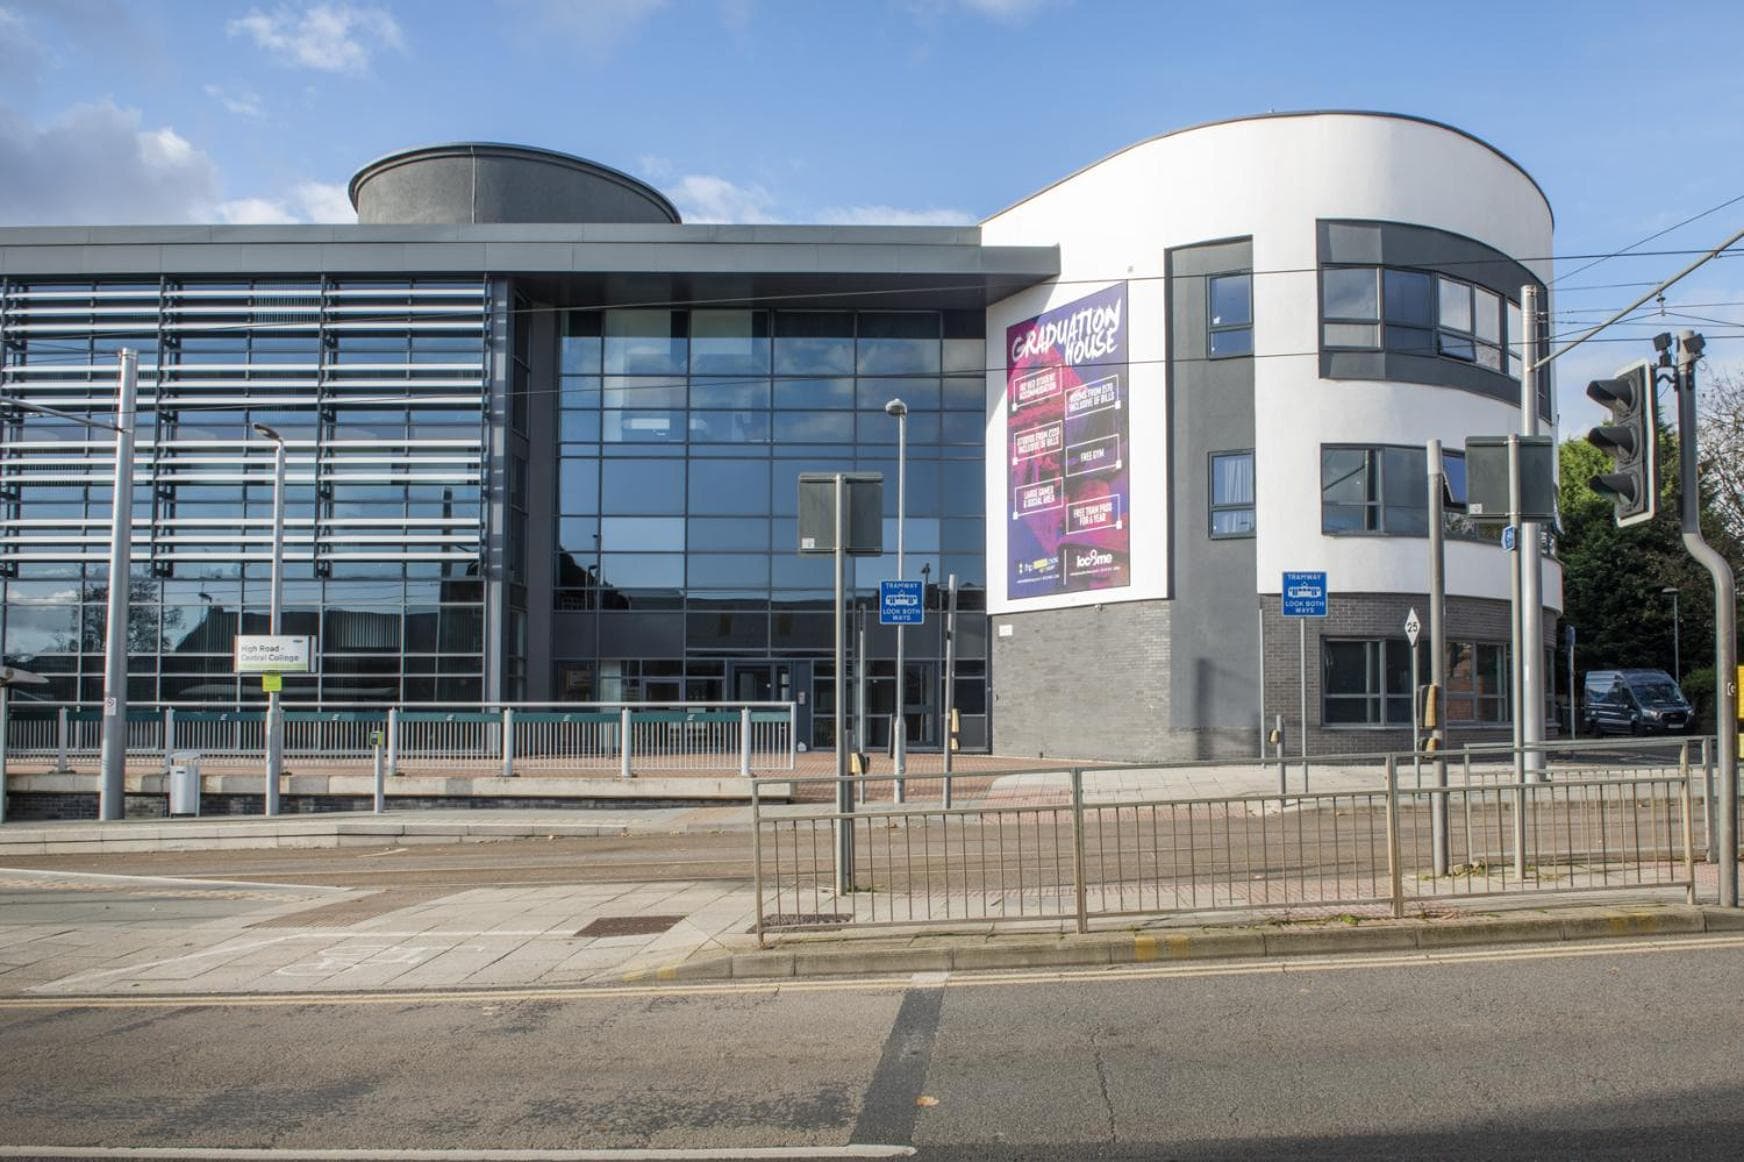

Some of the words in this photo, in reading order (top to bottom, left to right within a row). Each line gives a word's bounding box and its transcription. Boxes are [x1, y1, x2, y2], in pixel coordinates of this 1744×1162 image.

[1012, 297, 1121, 362] GRADUATION
[1065, 325, 1118, 366] HOUSE
[1080, 451, 1092, 462] FREE
[1093, 448, 1105, 459] GYM
[1073, 506, 1084, 518] FREE
[1407, 621, 1418, 633] 25
[241, 645, 257, 653] High
[259, 645, 280, 653] Road
[268, 654, 299, 663] College
